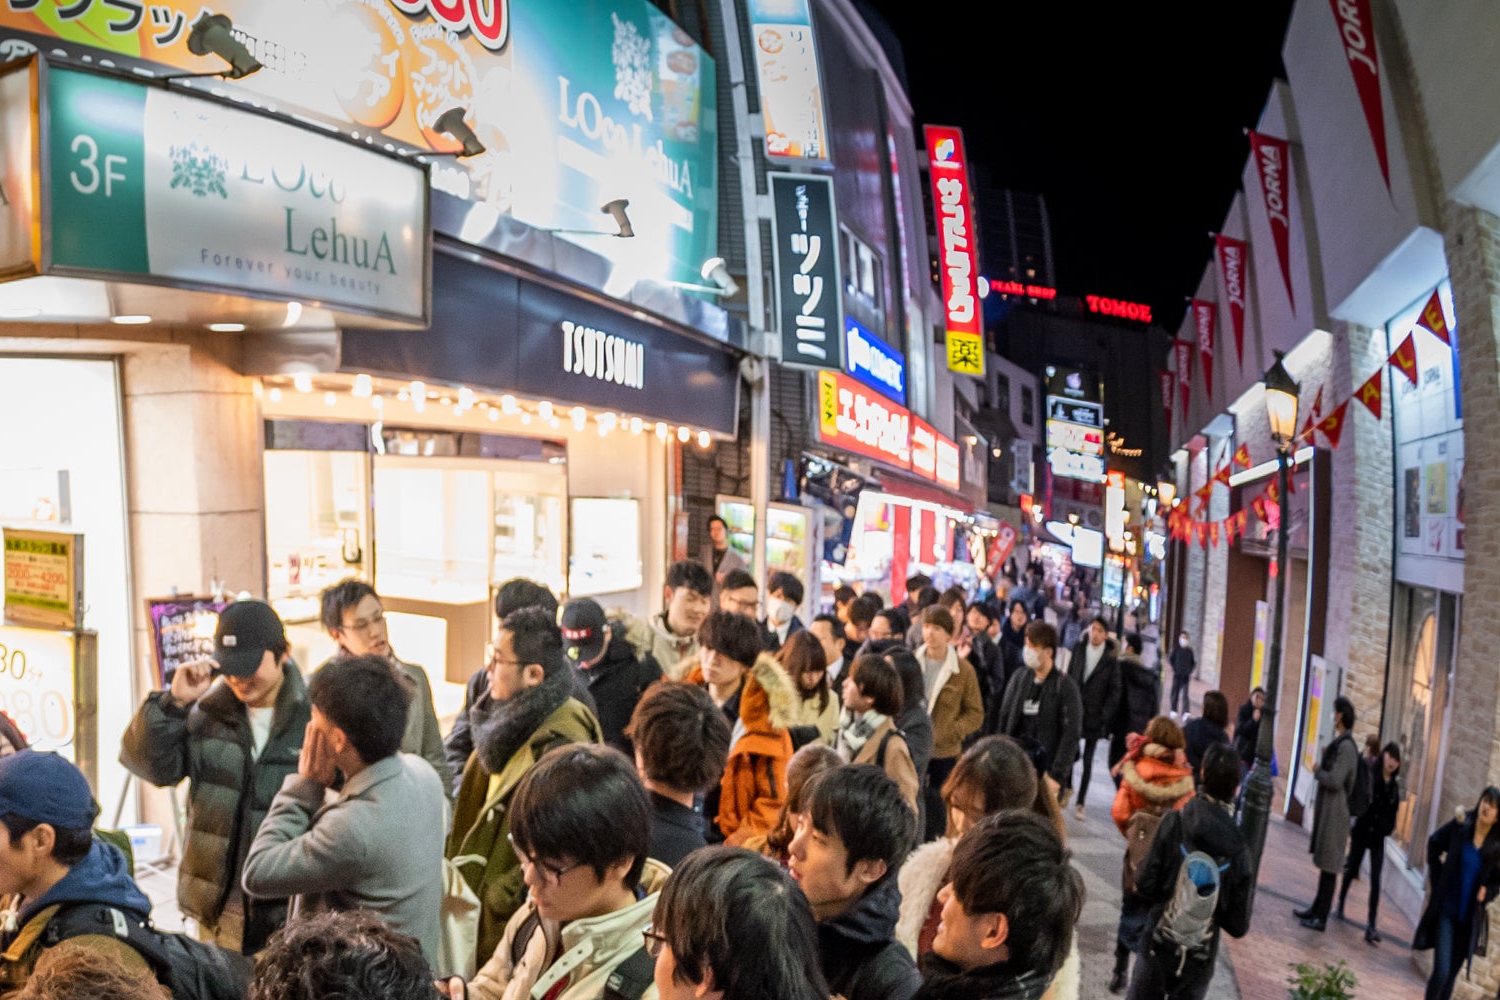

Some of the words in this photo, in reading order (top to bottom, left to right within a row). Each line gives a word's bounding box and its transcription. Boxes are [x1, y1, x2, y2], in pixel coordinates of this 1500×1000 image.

[1337, 0, 1377, 76] JOR
[69, 134, 129, 198] 3F
[1258, 143, 1289, 228] JORNA
[200, 249, 274, 274] Forever
[285, 264, 321, 285] your
[329, 274, 382, 296] beauty
[283, 205, 398, 276] LehuA
[790, 232, 828, 361] ツツミ
[1085, 294, 1153, 323] TOMOE
[1222, 245, 1245, 309] JORNA
[560, 320, 645, 391] TSUTSUMI
[951, 336, 980, 369] 薬
[1196, 305, 1213, 355] JORNA
